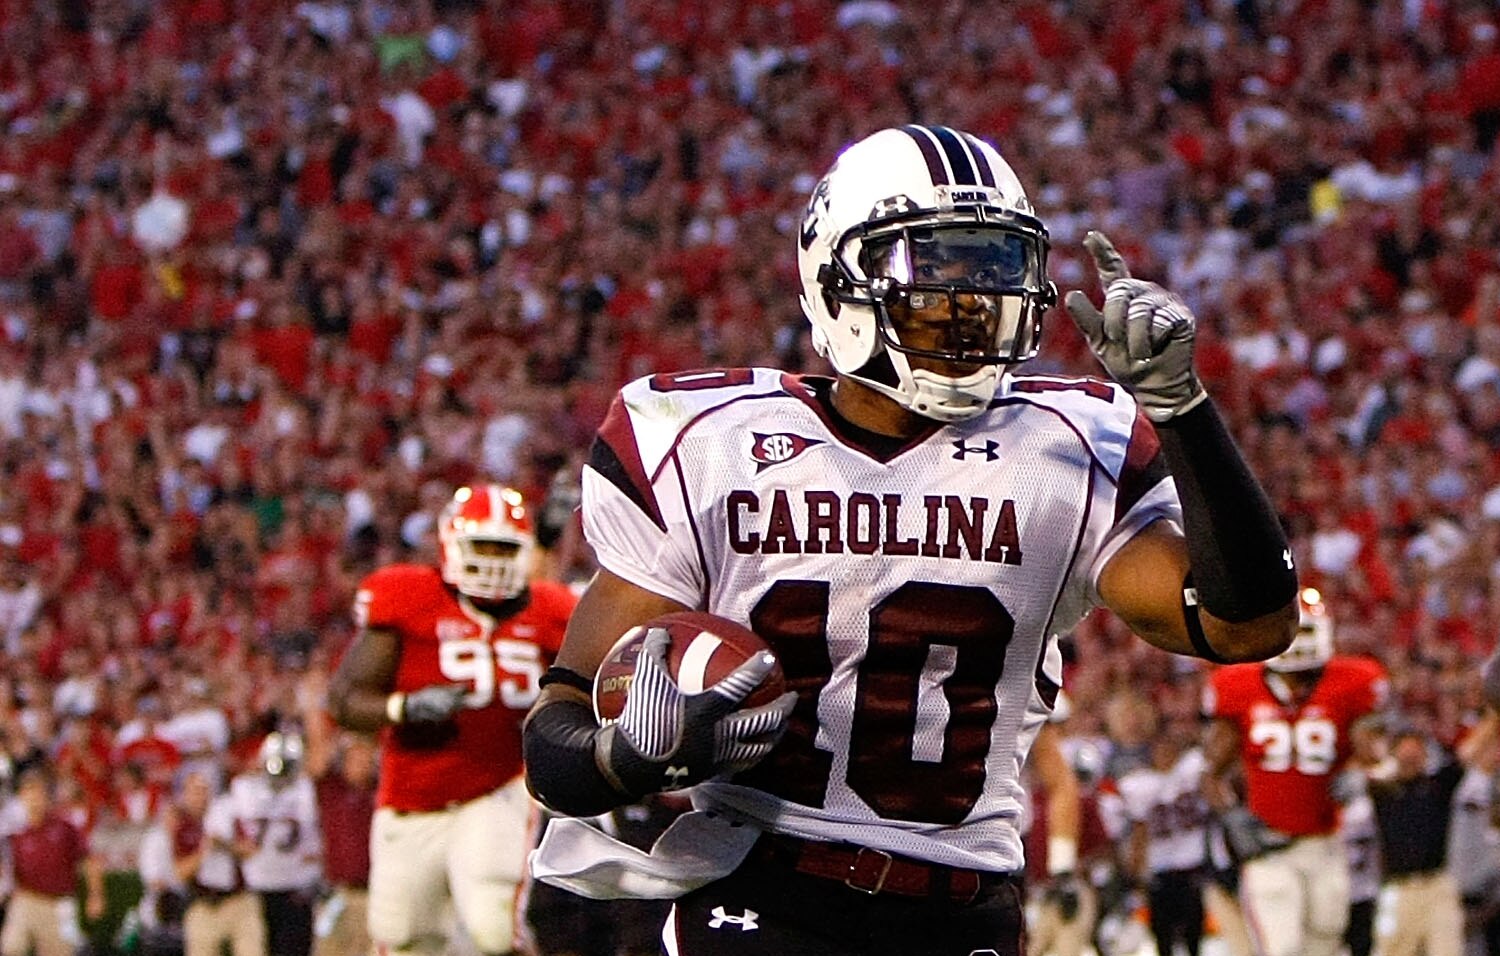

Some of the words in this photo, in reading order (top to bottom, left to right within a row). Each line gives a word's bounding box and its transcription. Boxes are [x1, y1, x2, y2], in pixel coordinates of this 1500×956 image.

[761, 435, 794, 461] SEC
[726, 489, 1023, 566] CAROLINA
[438, 638, 546, 709] 95
[750, 579, 1016, 826] 10
